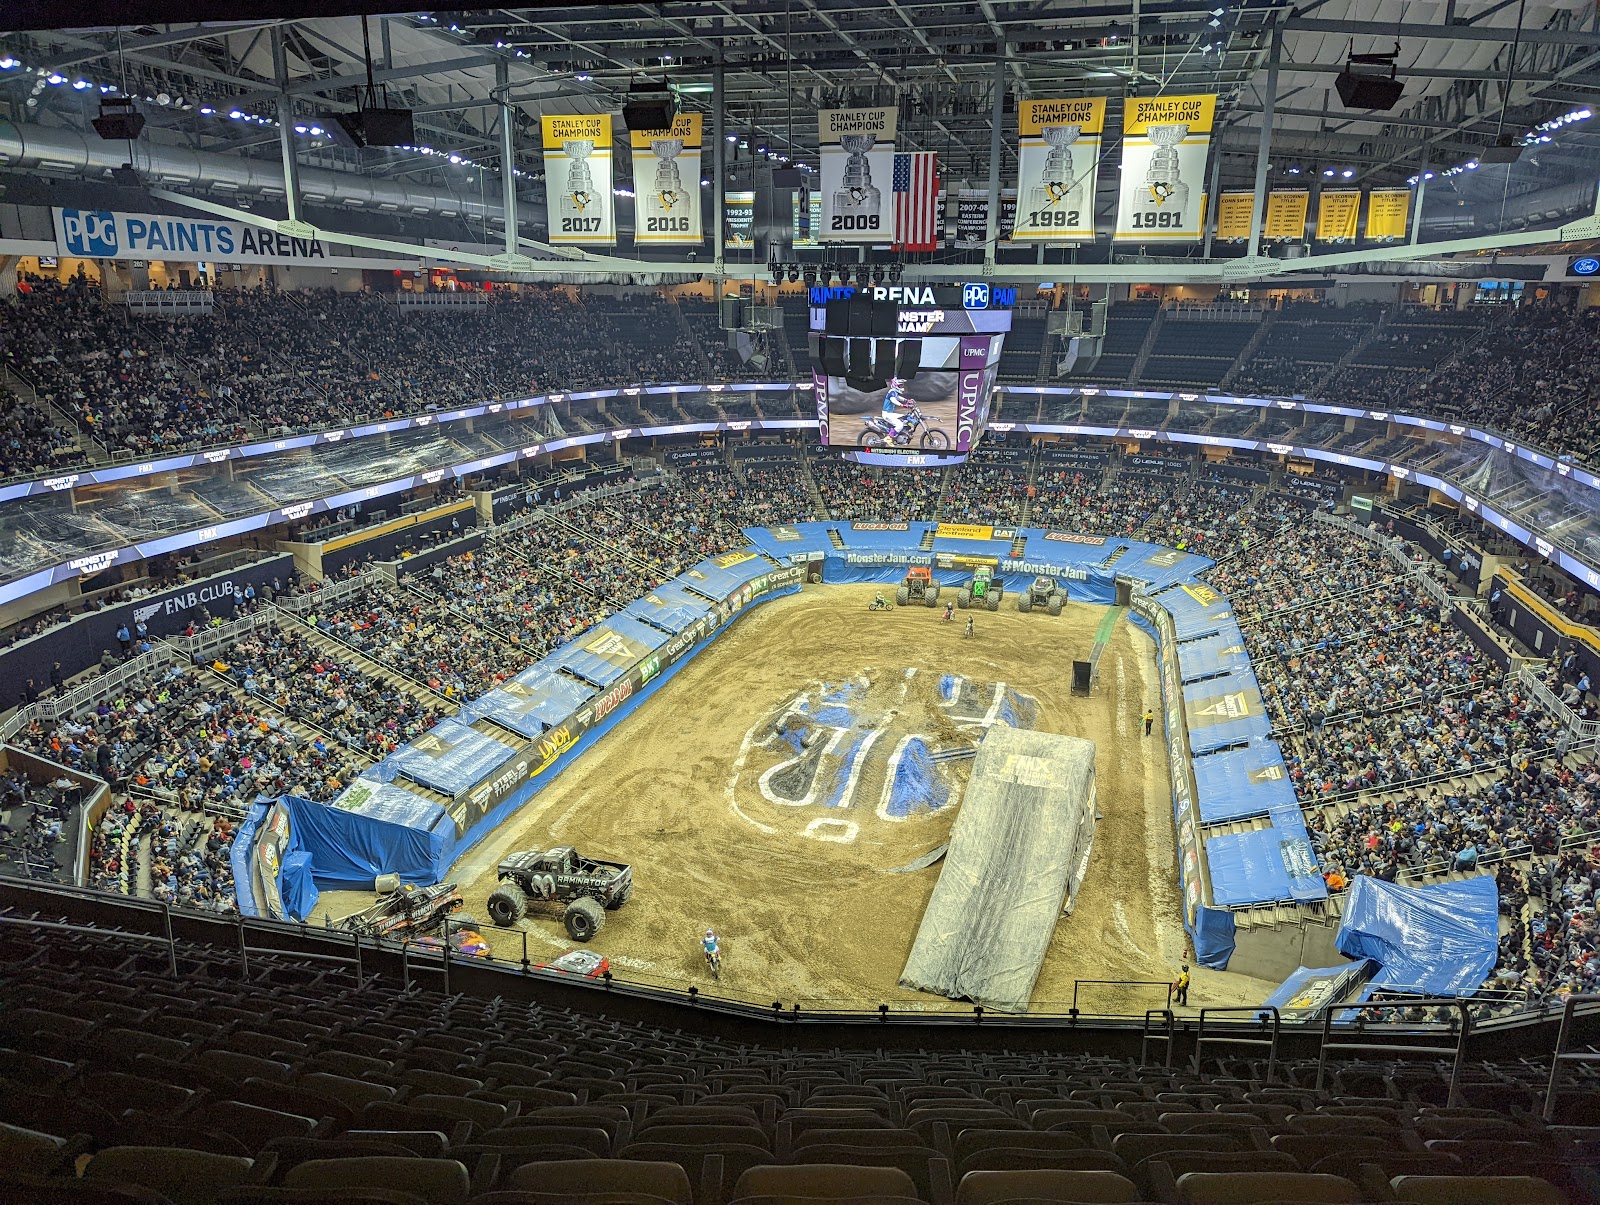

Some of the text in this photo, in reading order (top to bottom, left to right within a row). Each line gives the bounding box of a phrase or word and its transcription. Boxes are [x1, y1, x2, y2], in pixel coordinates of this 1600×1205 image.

[1032, 103, 1092, 113] STANLEY CUP
[1138, 101, 1202, 111] STANLEY CUP
[830, 112, 885, 122] STANLEY CUP
[1032, 112, 1091, 123] CHAMPIONS
[1137, 111, 1200, 122] CHAMPIONS
[552, 119, 601, 128] STANLEY CUP
[676, 119, 691, 127] CUP
[830, 121, 885, 131] CHAMPIONS
[553, 128, 601, 137] CHAMPIONS
[641, 129, 691, 137] CHAMPIONS
[562, 218, 601, 232] 2017
[647, 217, 690, 232] 2016
[832, 215, 880, 230] 2009
[1029, 211, 1080, 227] 1992
[1132, 212, 1183, 228] 1991
[64, 210, 325, 259] PPG PAINTS ARENA
[1578, 261, 1594, 271] Ford
[965, 287, 987, 306] PPG
[898, 312, 945, 323] NSTER
[964, 348, 986, 357] UPMC
[957, 372, 980, 444] UPMC
[907, 456, 926, 464] FMX
[138, 464, 154, 473] FMX
[1300, 480, 1321, 488] LEXUS
[366, 487, 379, 497] FMX
[853, 522, 889, 530] LUCAS
[938, 525, 981, 533] Cleveland
[199, 527, 218, 541] FMX
[994, 529, 1015, 537] CAT
[1045, 532, 1105, 545] LUCAS OIL
[70, 550, 119, 570] MONSTER
[847, 553, 931, 565] MonsterJam.com
[768, 566, 806, 582] Great Clips
[1001, 560, 1087, 580] #MonsterJam
[751, 577, 767, 591] BKT
[1587, 571, 1599, 586] FMX
[200, 581, 233, 602] CLUB
[1131, 593, 1149, 609] Great
[254, 615, 267, 624] 122
[666, 640, 685, 655] Great
[682, 630, 697, 643] Clips
[640, 657, 660, 677] BKT
[594, 678, 633, 722] LUCAS OIL
[538, 725, 571, 759] UNOH
[1007, 755, 1050, 773] FMX
[492, 761, 528, 789] STEEL 2
[557, 875, 608, 887] RAMINATOR
